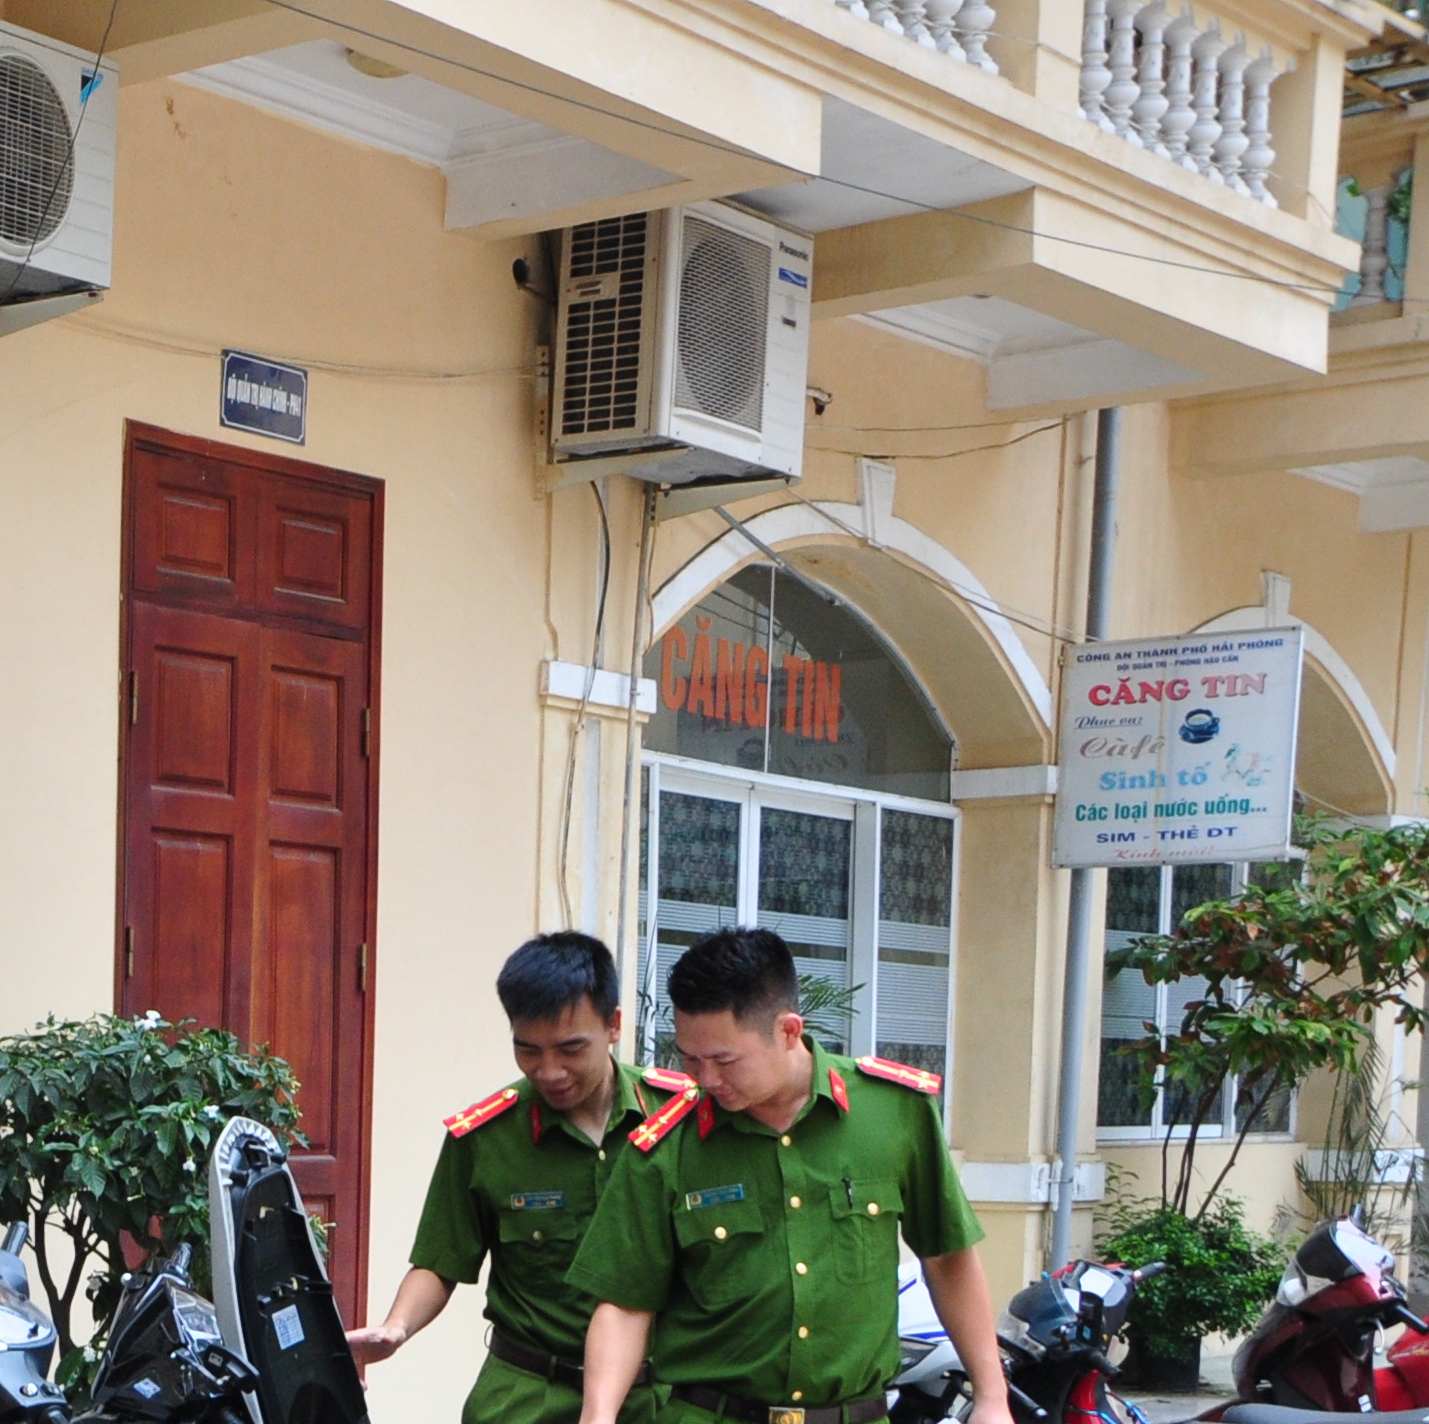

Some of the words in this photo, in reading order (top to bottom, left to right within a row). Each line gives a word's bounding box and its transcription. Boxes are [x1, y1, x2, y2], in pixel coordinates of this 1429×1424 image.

[1076, 652, 1112, 663] CÔNG
[1115, 651, 1132, 660] AN
[661, 615, 769, 728] CĂNG
[782, 653, 840, 744] TIN
[1088, 676, 1191, 706] CĂNG
[1201, 673, 1268, 698] TIN
[1099, 770, 1165, 790] Sinh
[1075, 803, 1108, 822] Các
[1114, 801, 1147, 823] loại
[1153, 797, 1198, 818] nước
[1096, 832, 1136, 843] SIM
